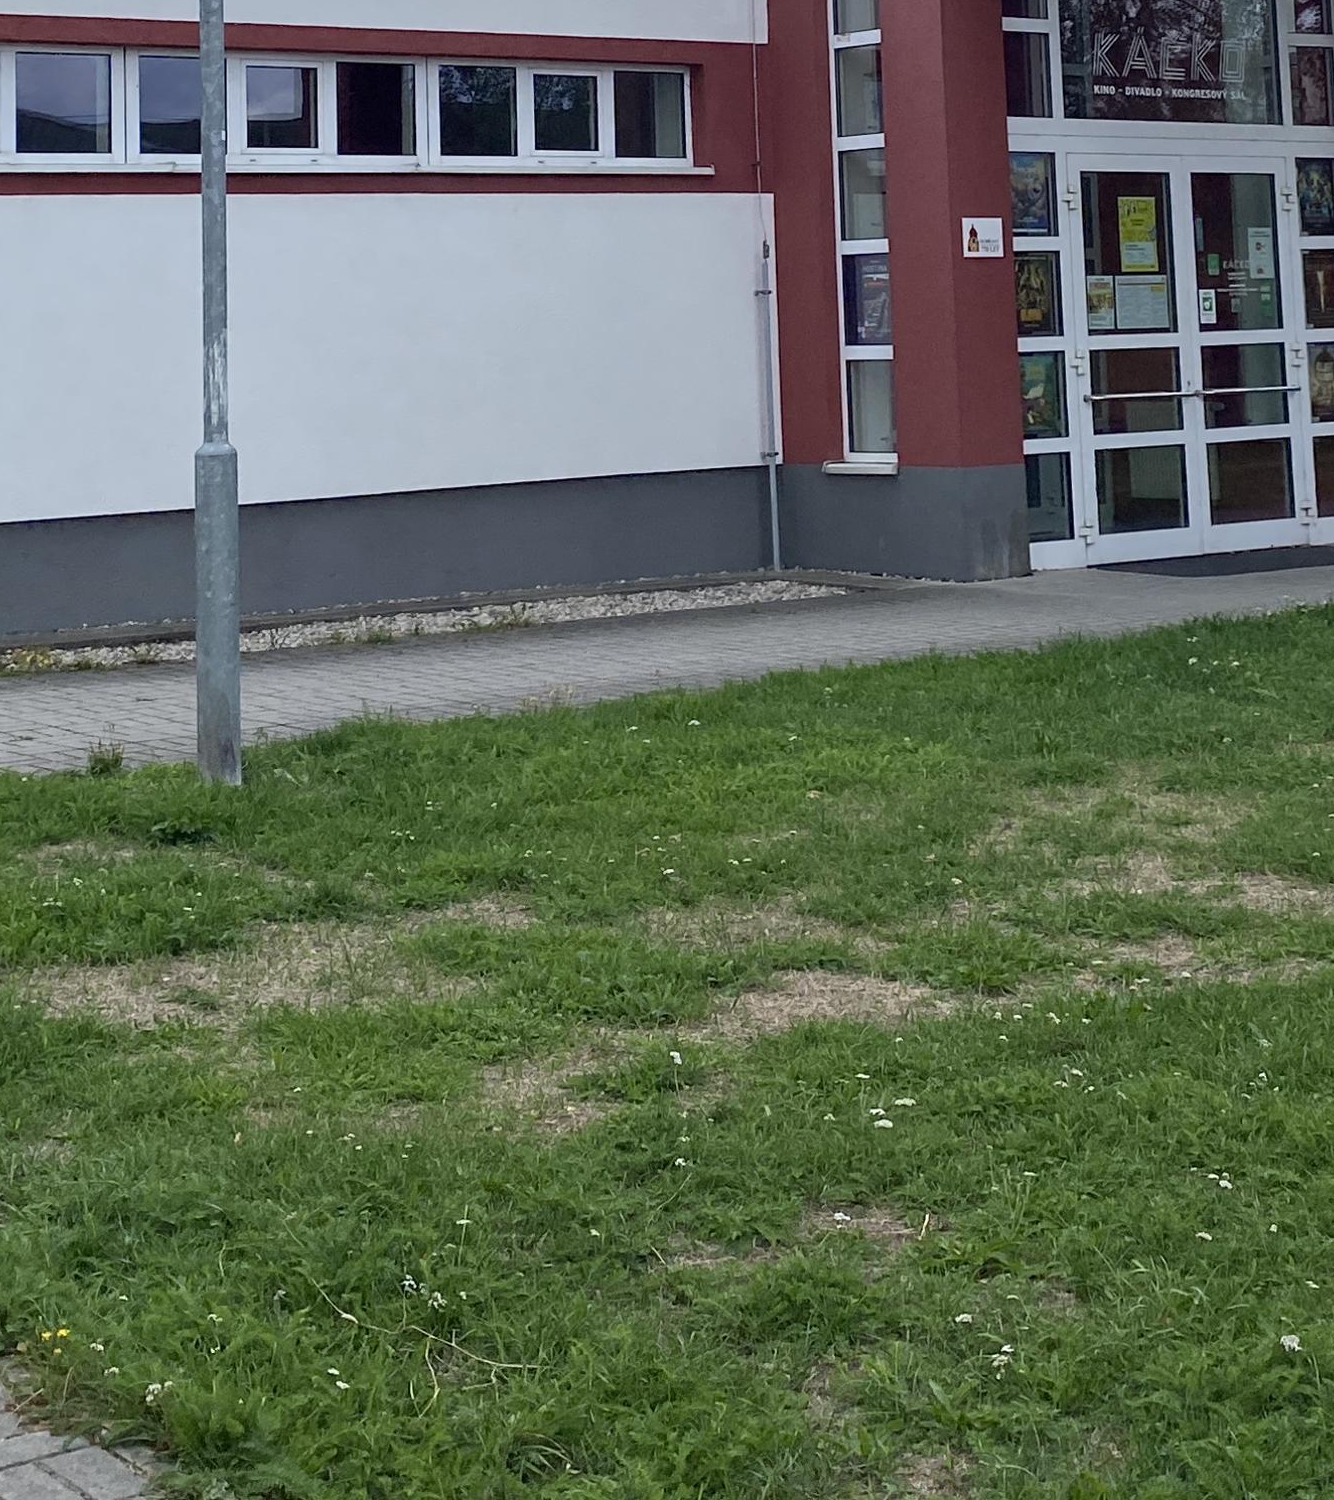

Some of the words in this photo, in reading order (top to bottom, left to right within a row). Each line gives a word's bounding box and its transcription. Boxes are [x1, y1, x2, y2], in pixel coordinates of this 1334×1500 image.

[1092, 26, 1246, 83] KÁČKO
[1093, 85, 1116, 95] KINO
[1125, 86, 1163, 97] DIVADLO
[1171, 88, 1227, 100] KONGRESOVÝ
